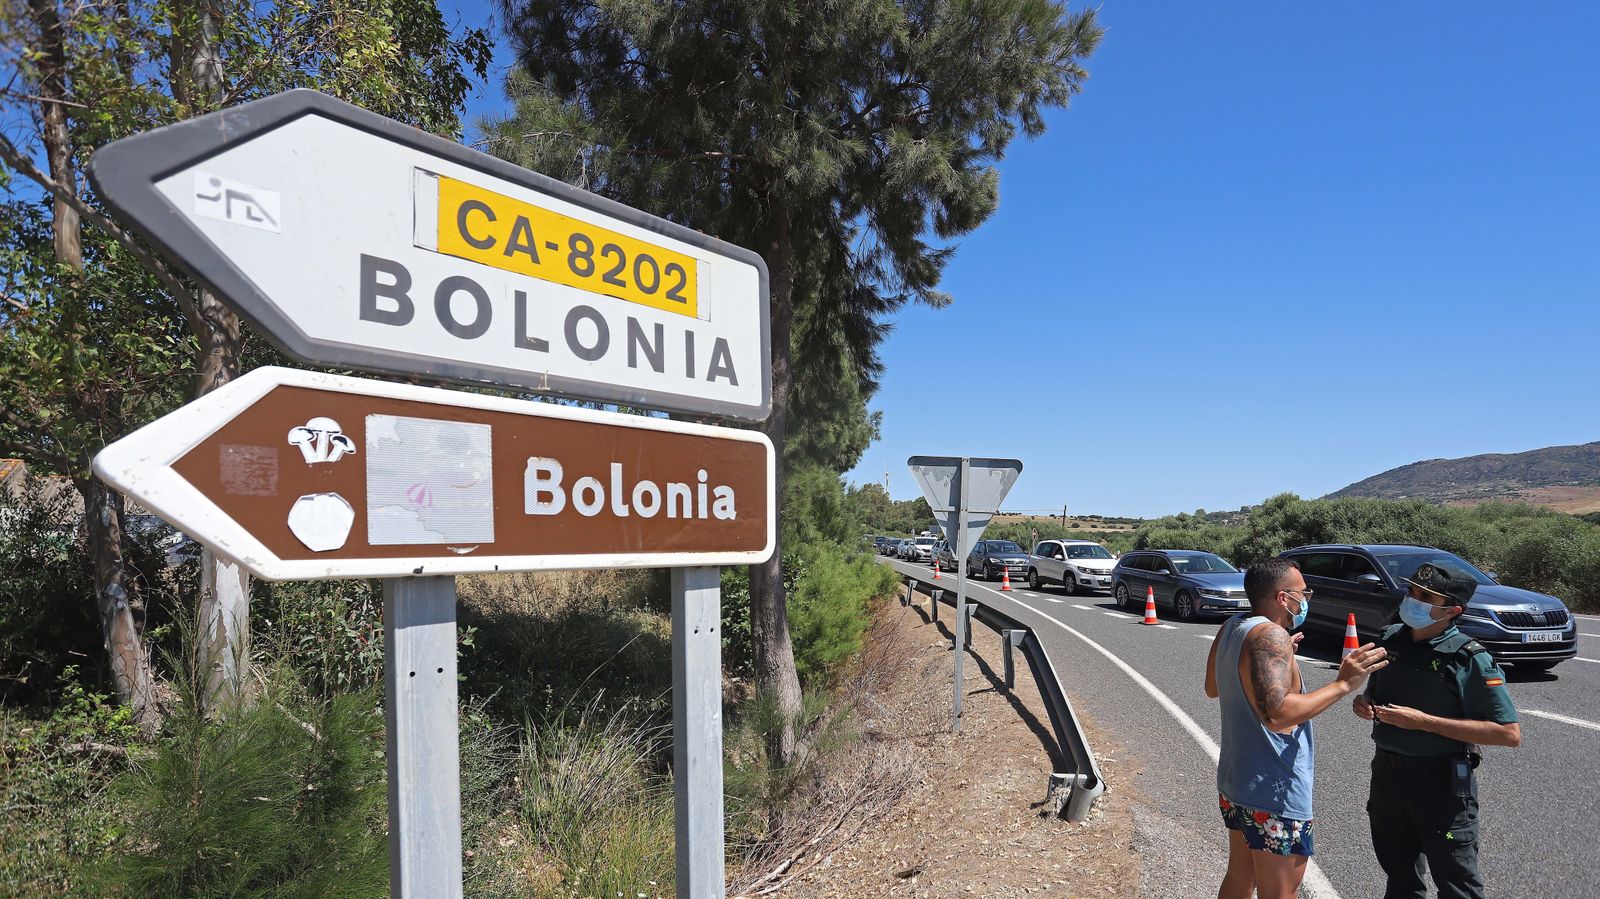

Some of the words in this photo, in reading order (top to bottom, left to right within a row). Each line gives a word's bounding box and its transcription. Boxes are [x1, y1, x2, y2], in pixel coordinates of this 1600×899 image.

[457, 200, 687, 304] CA-8202
[360, 253, 739, 387] BOLONIA
[524, 456, 737, 520] Bolonia
[1528, 633, 1546, 642] 1446
